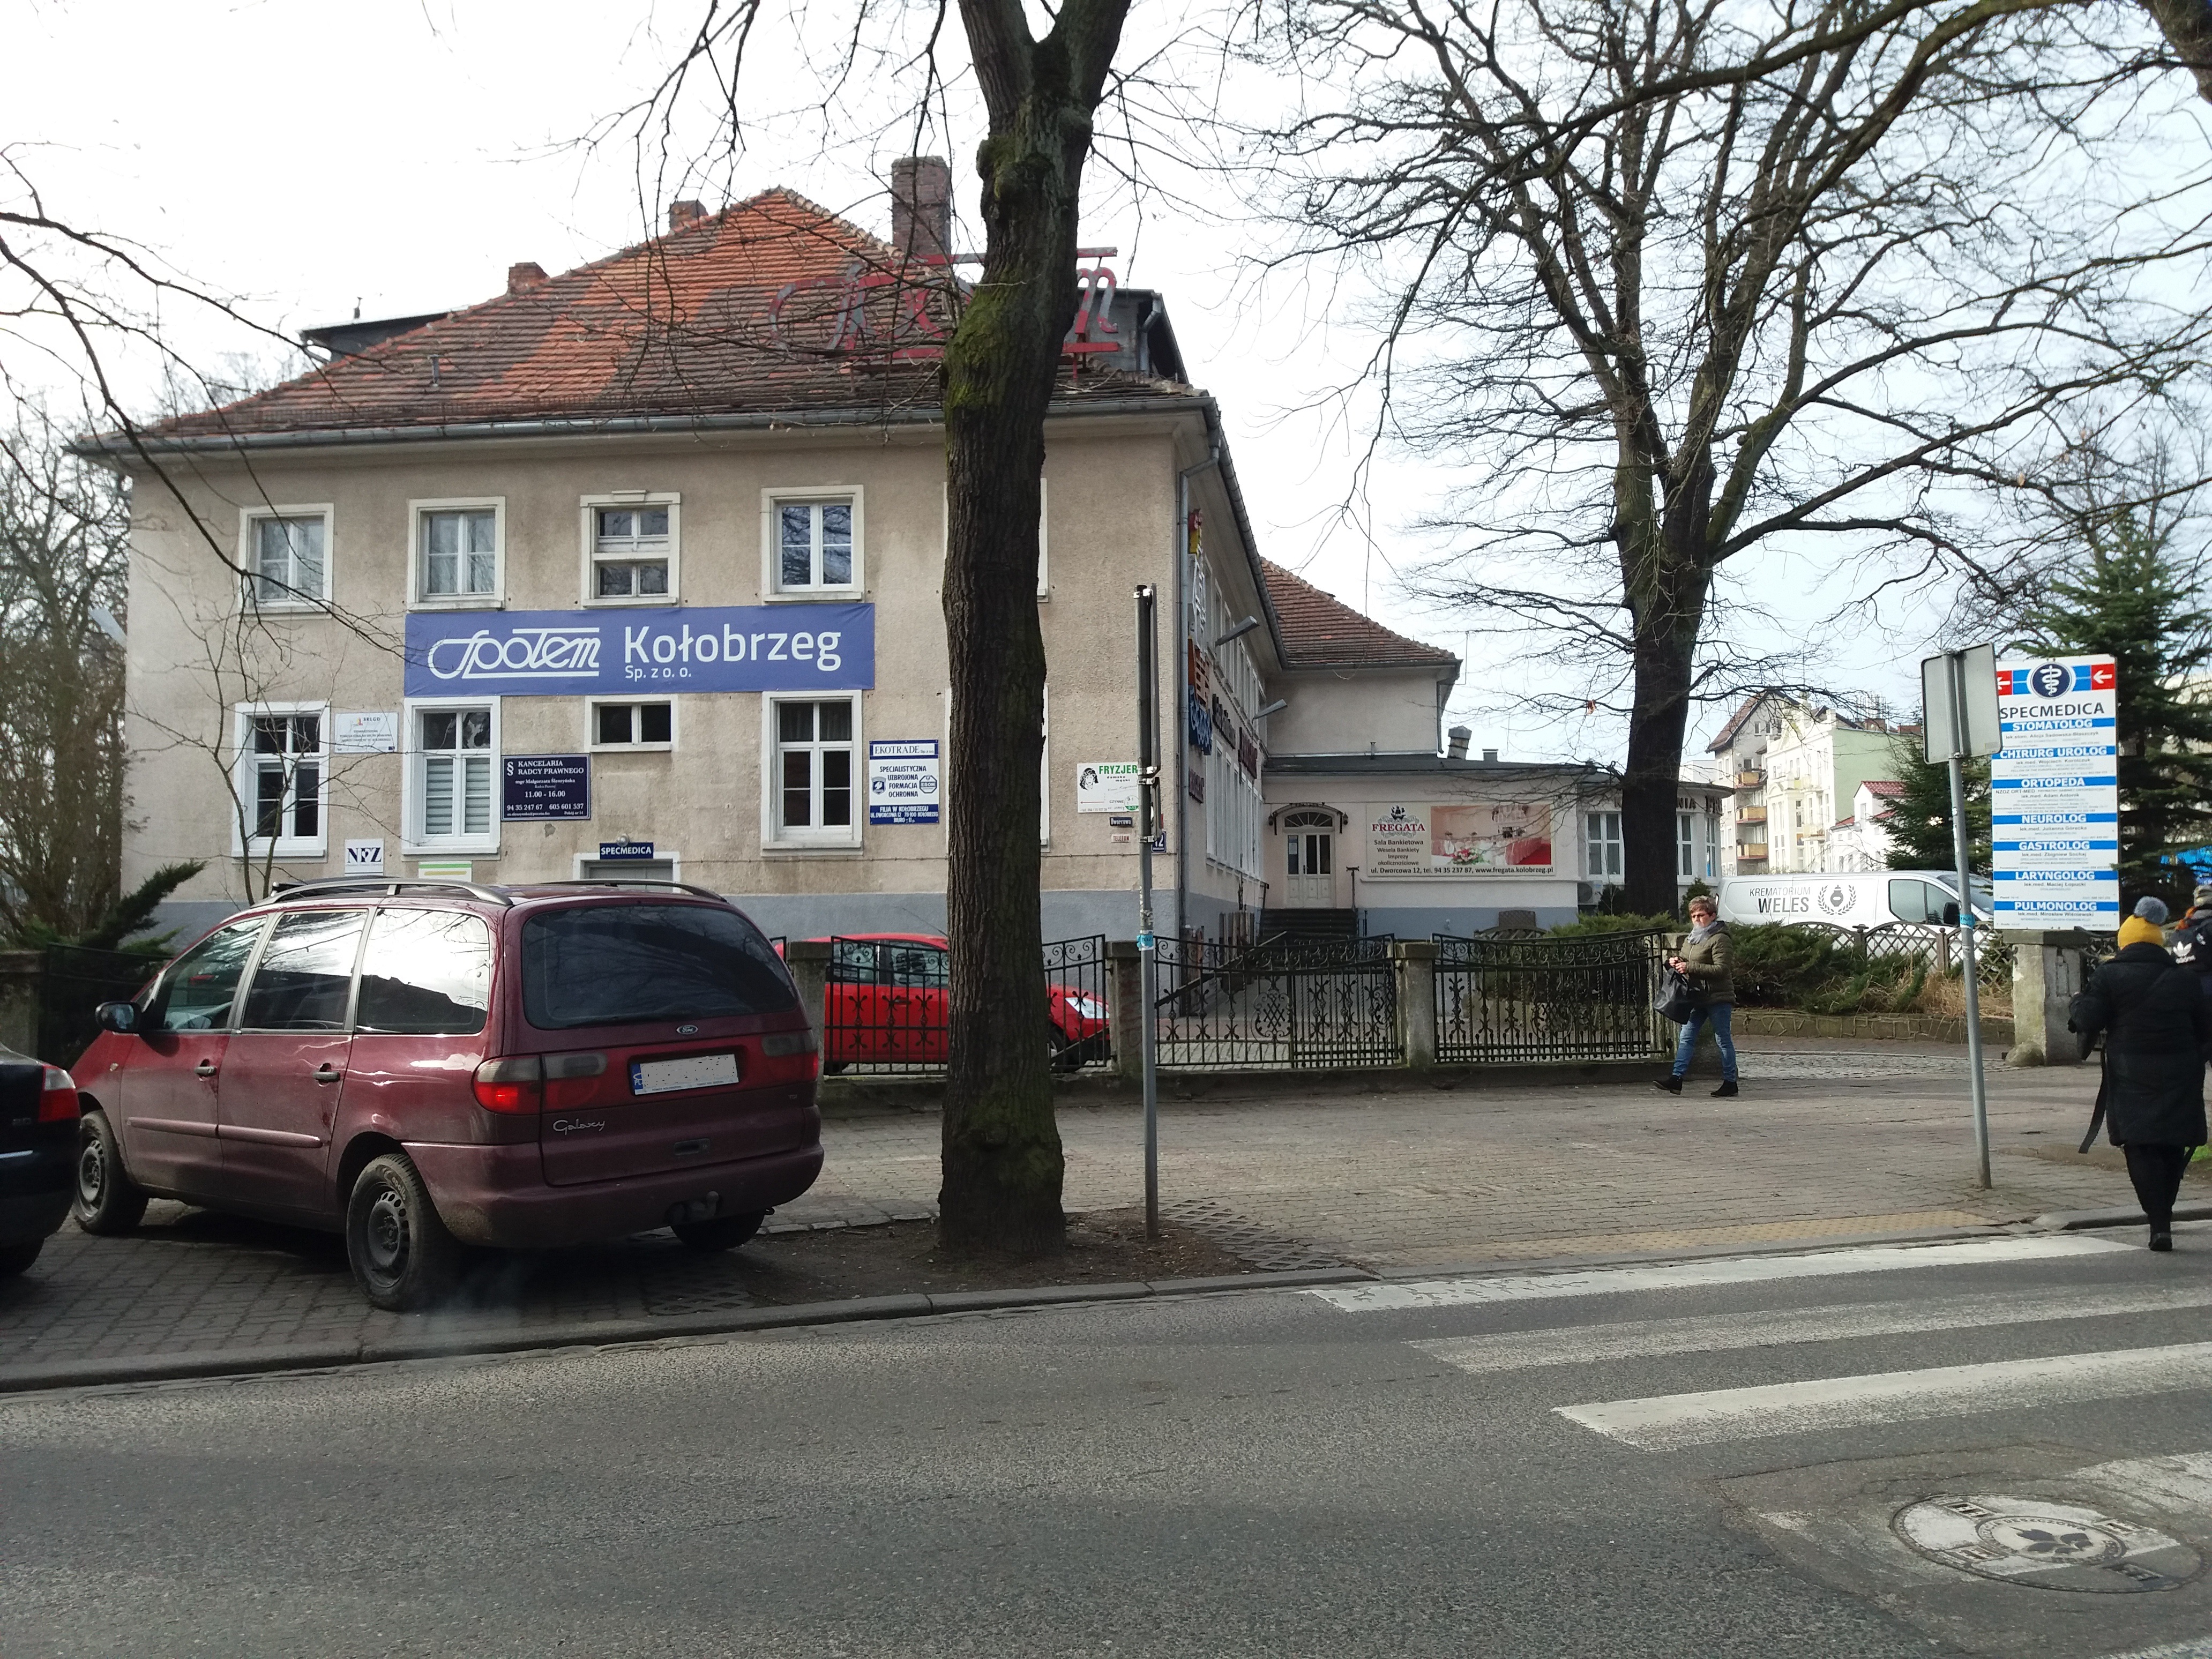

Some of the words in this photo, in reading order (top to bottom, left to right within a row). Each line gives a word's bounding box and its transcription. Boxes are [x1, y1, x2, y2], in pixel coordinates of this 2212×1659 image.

[624, 623, 842, 671] Kołobrzeg
[625, 665, 647, 682] Sp.
[651, 668, 659, 678] z
[662, 667, 676, 678] o.
[679, 666, 692, 677] o.
[2000, 702, 2105, 719] SPECMEDICA
[2012, 719, 2093, 731] STOMATOLOG
[875, 745, 920, 754] EKOTRADE
[1999, 749, 2054, 759] CHIRURG
[2057, 746, 2107, 758] UROLOG
[1099, 765, 1138, 774] FRYZJER
[2021, 778, 2085, 788] ORTOPEDA
[2021, 814, 2087, 824] NEUROLOG
[1372, 823, 1425, 832] FREGATA
[601, 846, 652, 855] SPECMEDICA
[2019, 841, 2090, 850] GASTROLOG
[347, 847, 382, 864] NFZ
[2015, 871, 2095, 880] LARYNGOLOG
[1750, 886, 1811, 896] KREMATORIUM
[1758, 896, 1810, 913] WELES
[2014, 902, 2097, 911] PULMONOLOG
[552, 1118, 606, 1135] Galaxy
